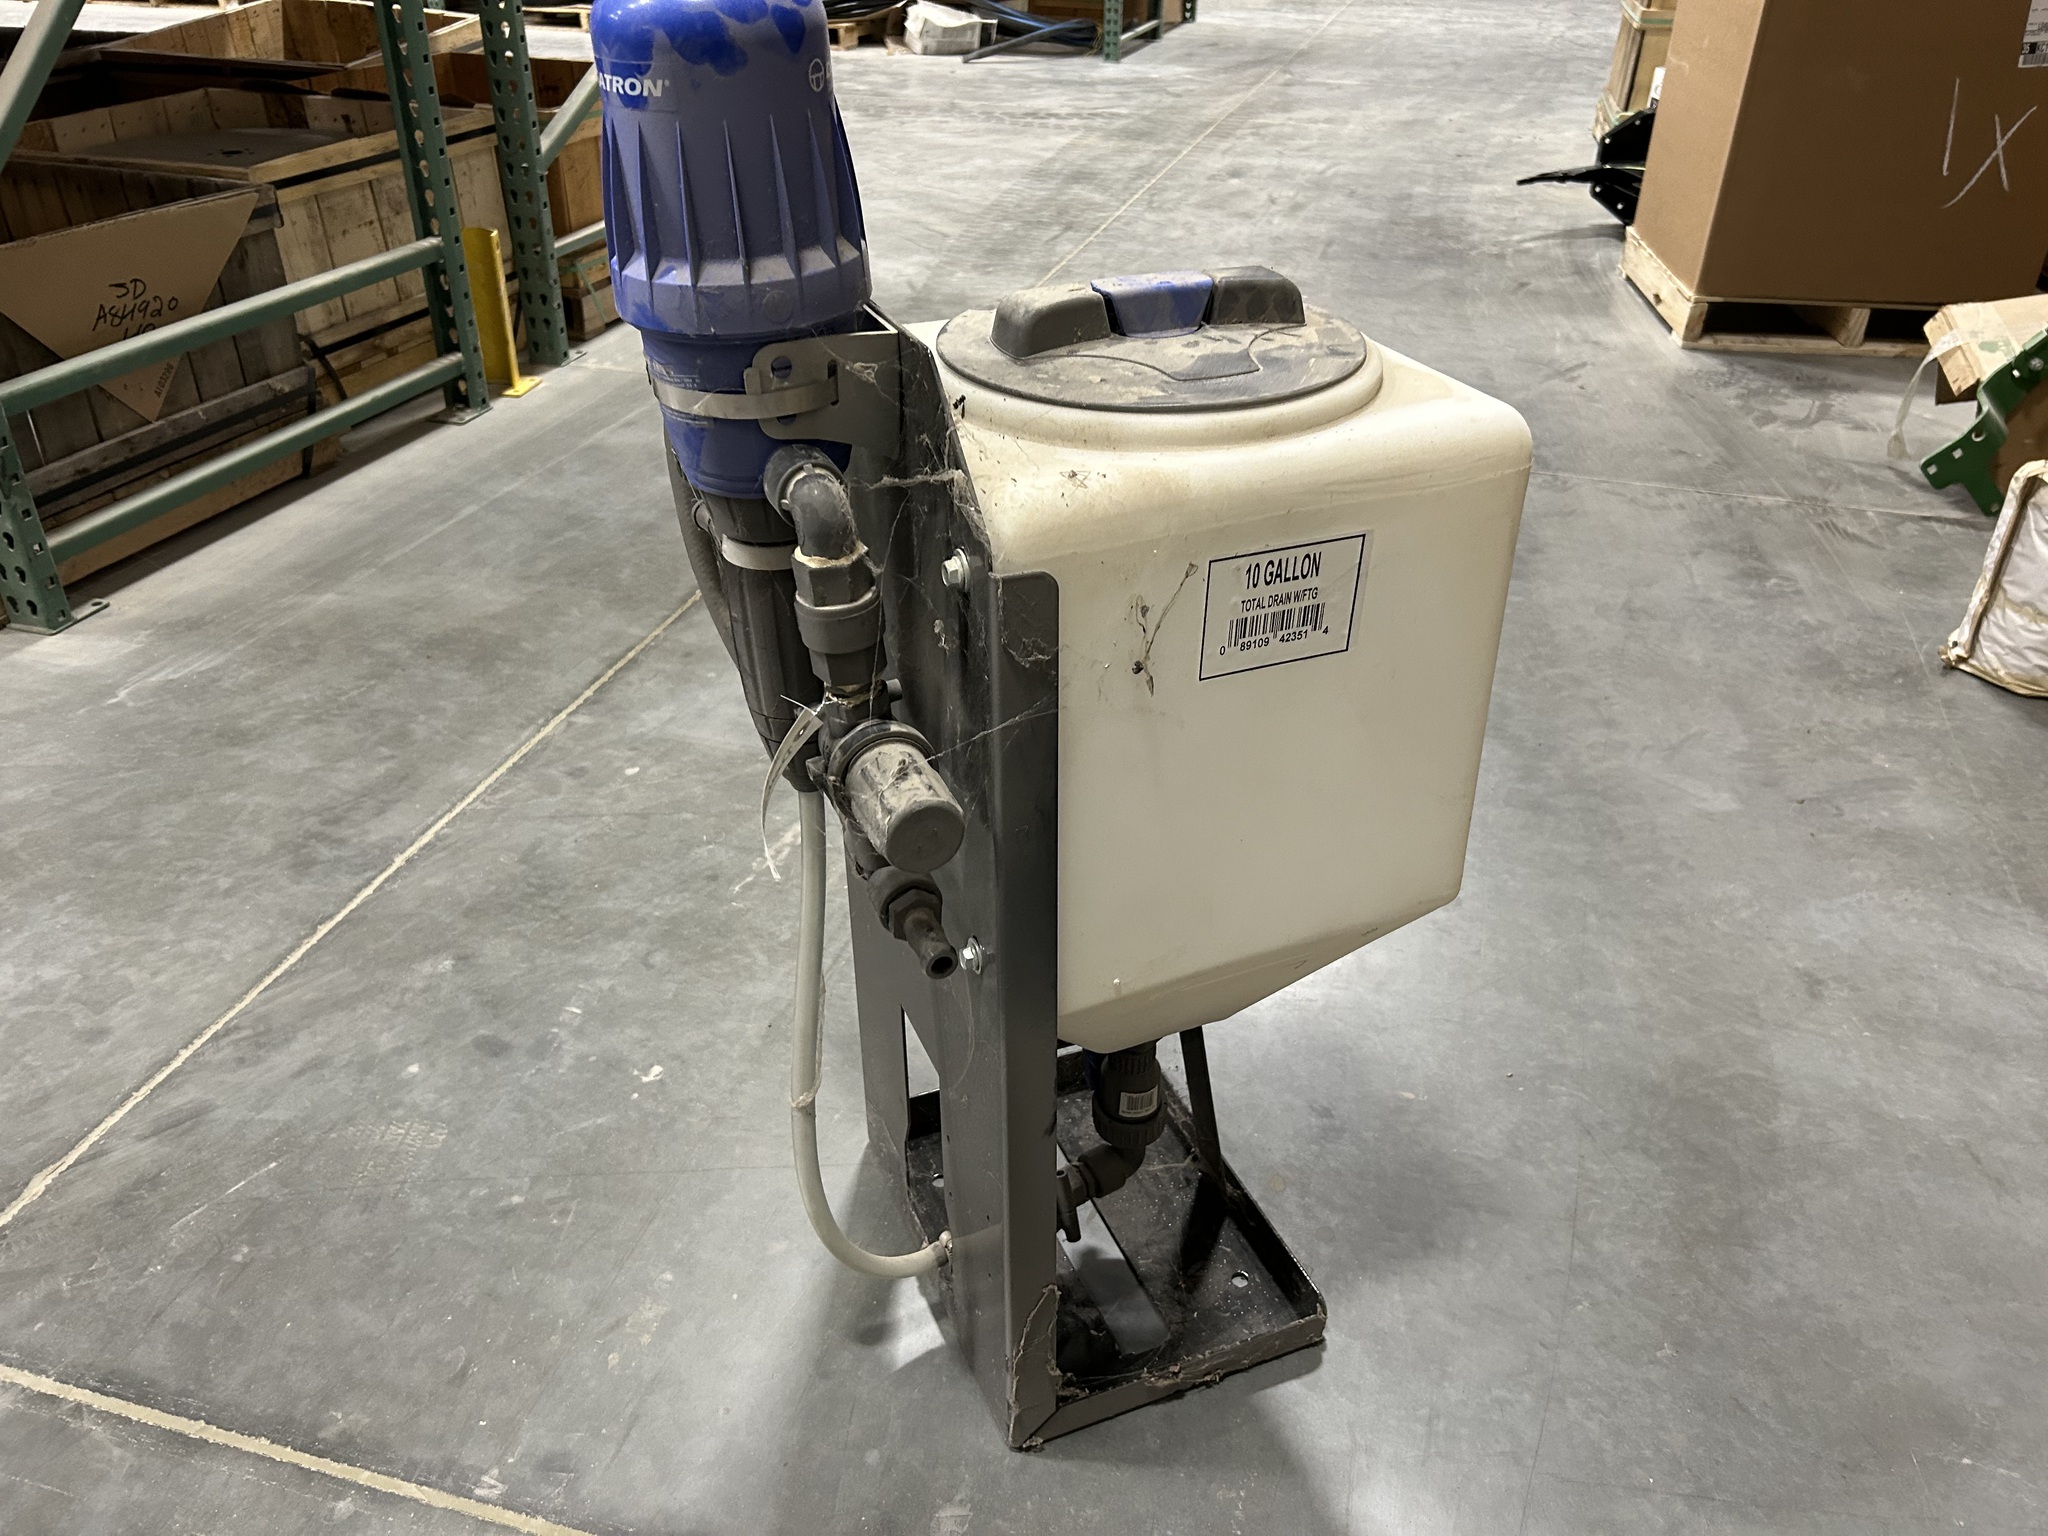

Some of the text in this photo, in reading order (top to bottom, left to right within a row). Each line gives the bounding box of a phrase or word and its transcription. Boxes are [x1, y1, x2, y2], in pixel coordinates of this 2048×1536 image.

[1246, 551, 1322, 589] 10 GALLON
[1241, 587, 1319, 612] TOTAL DRAIN W/FTG
[1219, 625, 1329, 656] 0 89109 42351 4
